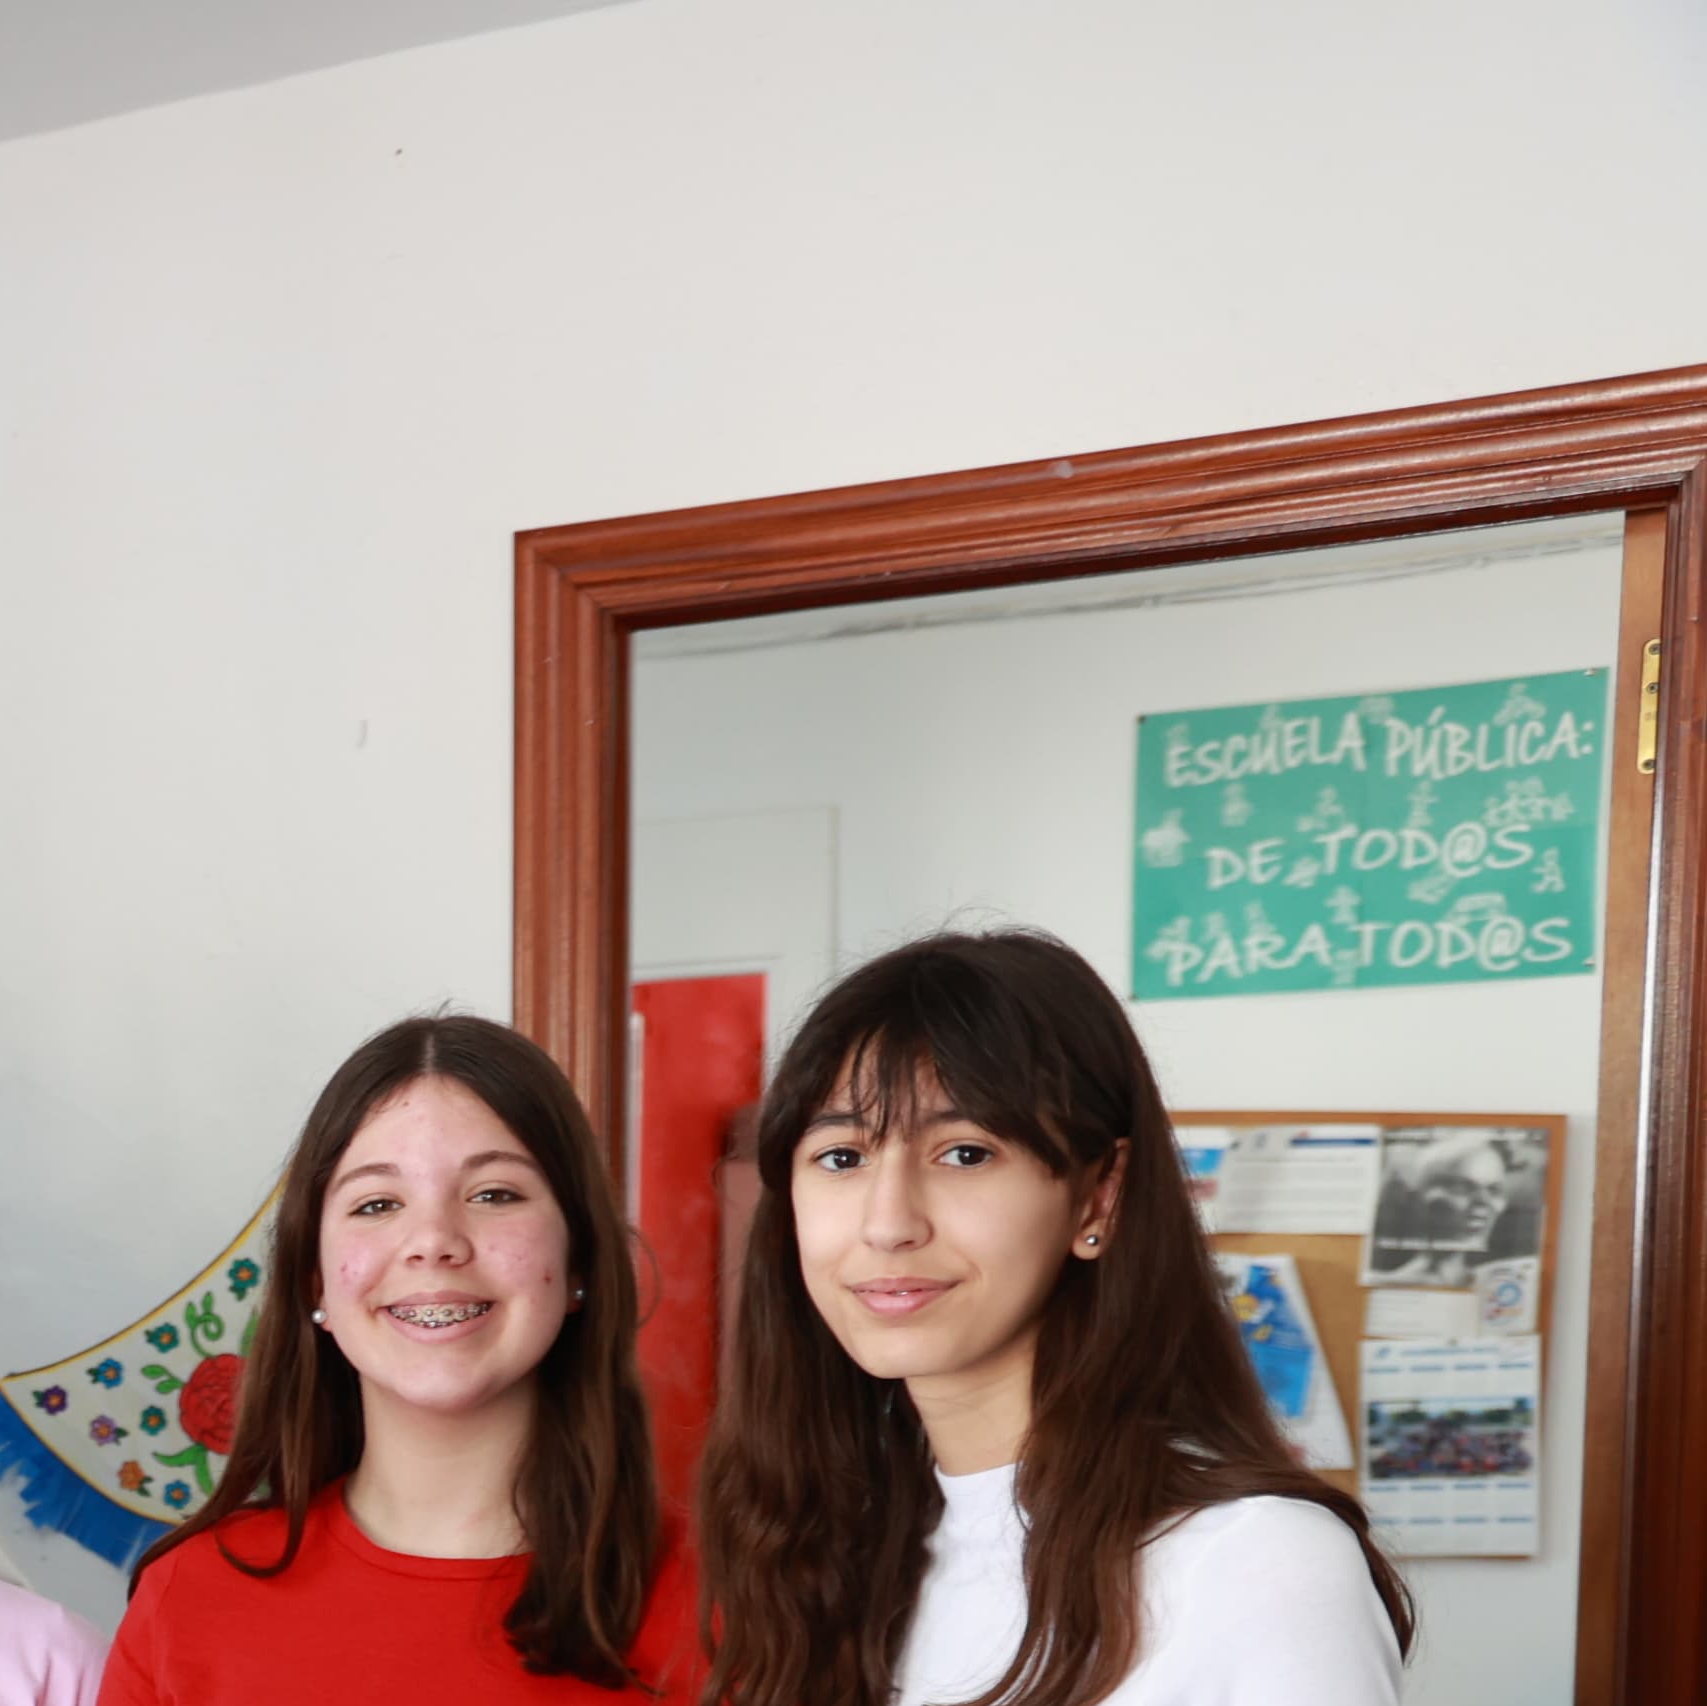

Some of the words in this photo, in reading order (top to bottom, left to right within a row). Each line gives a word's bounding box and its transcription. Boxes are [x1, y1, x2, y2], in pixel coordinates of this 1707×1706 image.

[1164, 711, 1367, 788] ESCUELA
[1383, 705, 1595, 781] PÚBLICA:
[1204, 838, 1286, 890] DE
[1315, 821, 1535, 877] TOD@S
[1165, 922, 1333, 987] PARA
[1350, 917, 1573, 973] TOD@S
